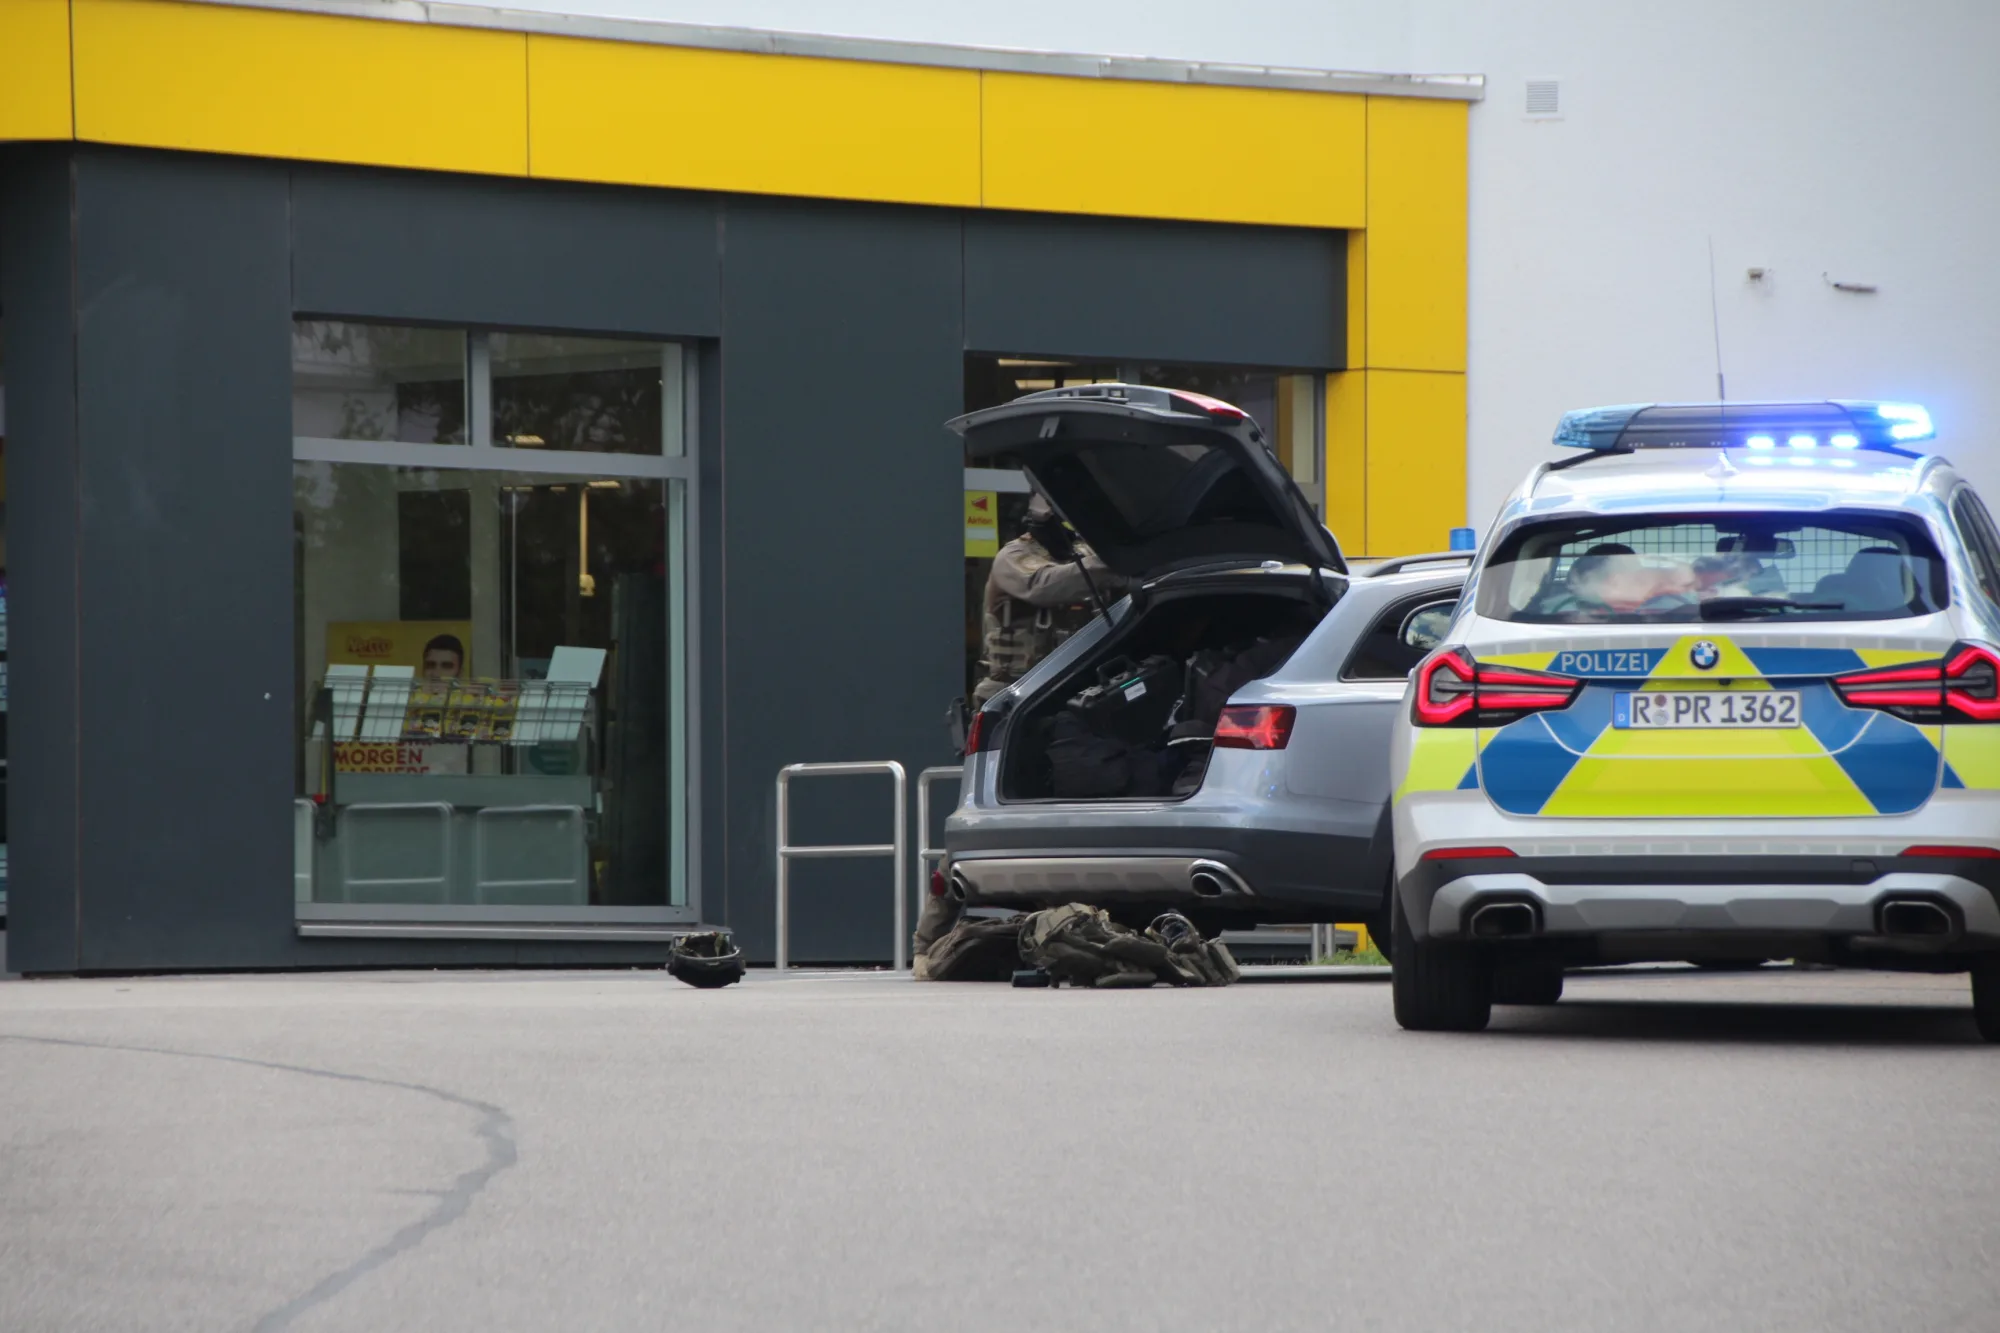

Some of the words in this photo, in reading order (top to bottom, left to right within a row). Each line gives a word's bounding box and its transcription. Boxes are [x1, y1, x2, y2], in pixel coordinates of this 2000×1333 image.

[1561, 653, 1648, 672] POLIZEI
[1633, 696, 1651, 723] R
[1674, 696, 1711, 723] PR
[1720, 695, 1796, 723] 1362
[333, 748, 423, 765] MORGEN
